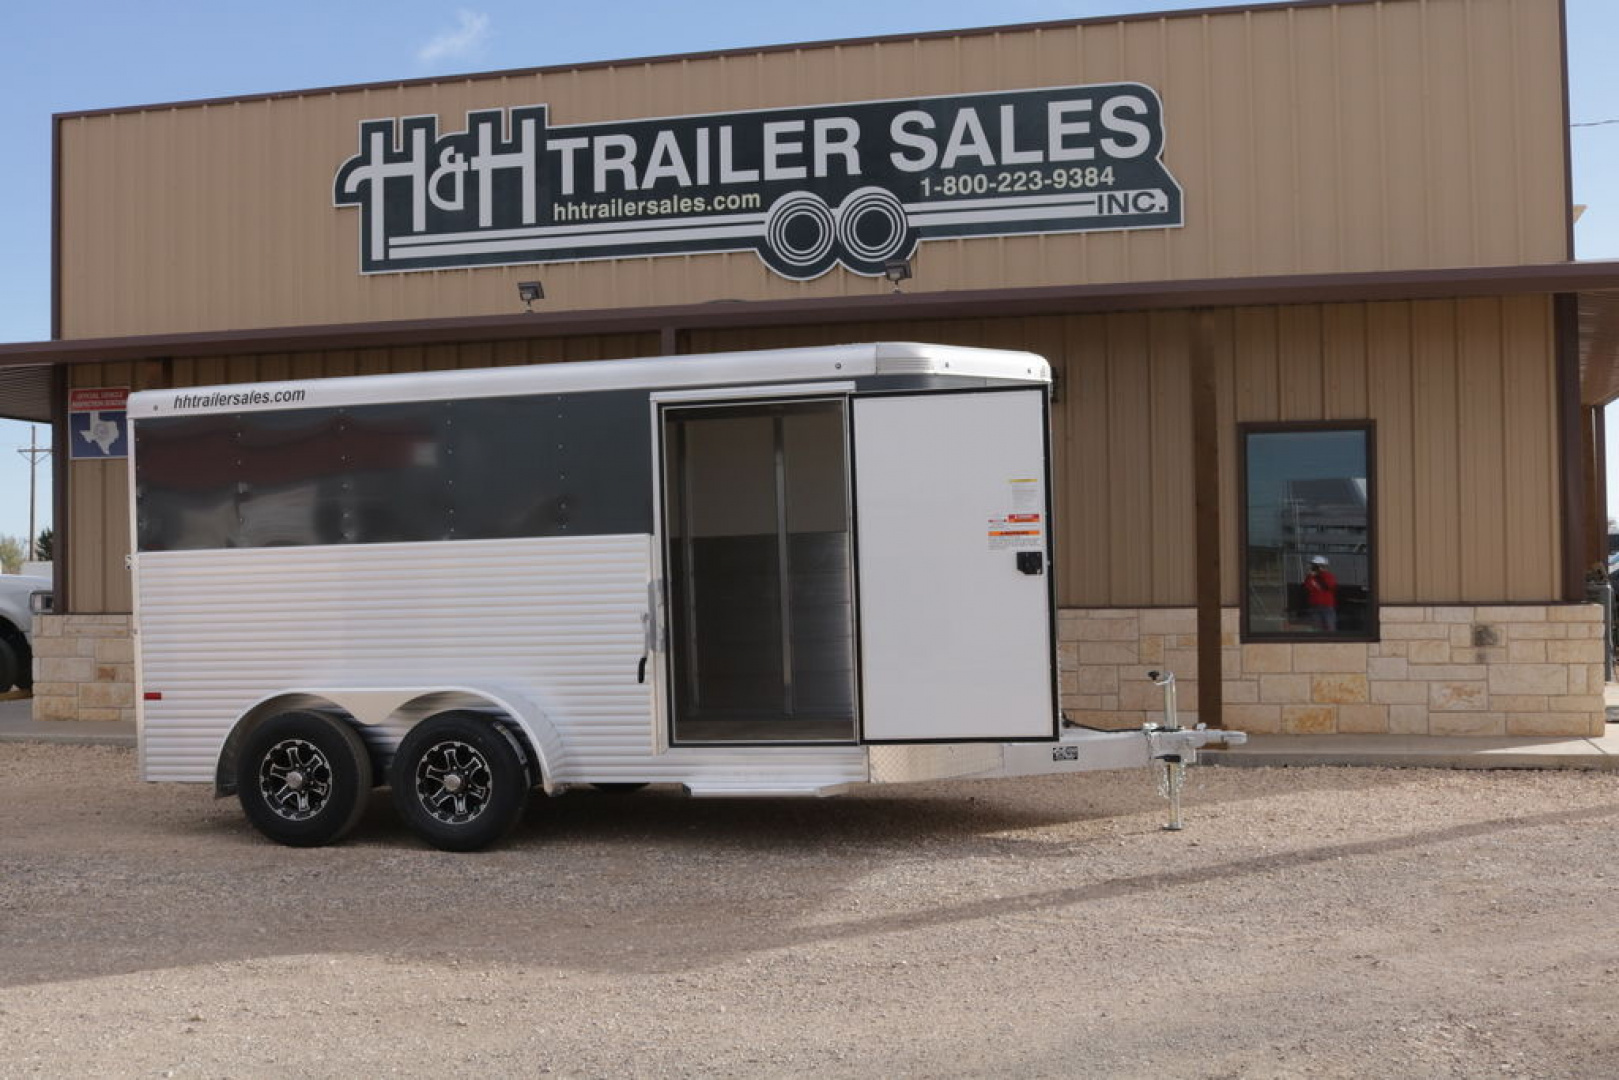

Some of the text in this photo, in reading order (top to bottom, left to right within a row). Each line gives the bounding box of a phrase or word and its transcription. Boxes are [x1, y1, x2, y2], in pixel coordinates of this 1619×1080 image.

[344, 95, 1151, 261] H&H TRAILER SALES
[920, 166, 1115, 197] 1-800-223-9384
[553, 192, 761, 221] hhtrailersales.com
[1097, 194, 1167, 214] INC.
[173, 389, 306, 409] hhtrailersales.com
